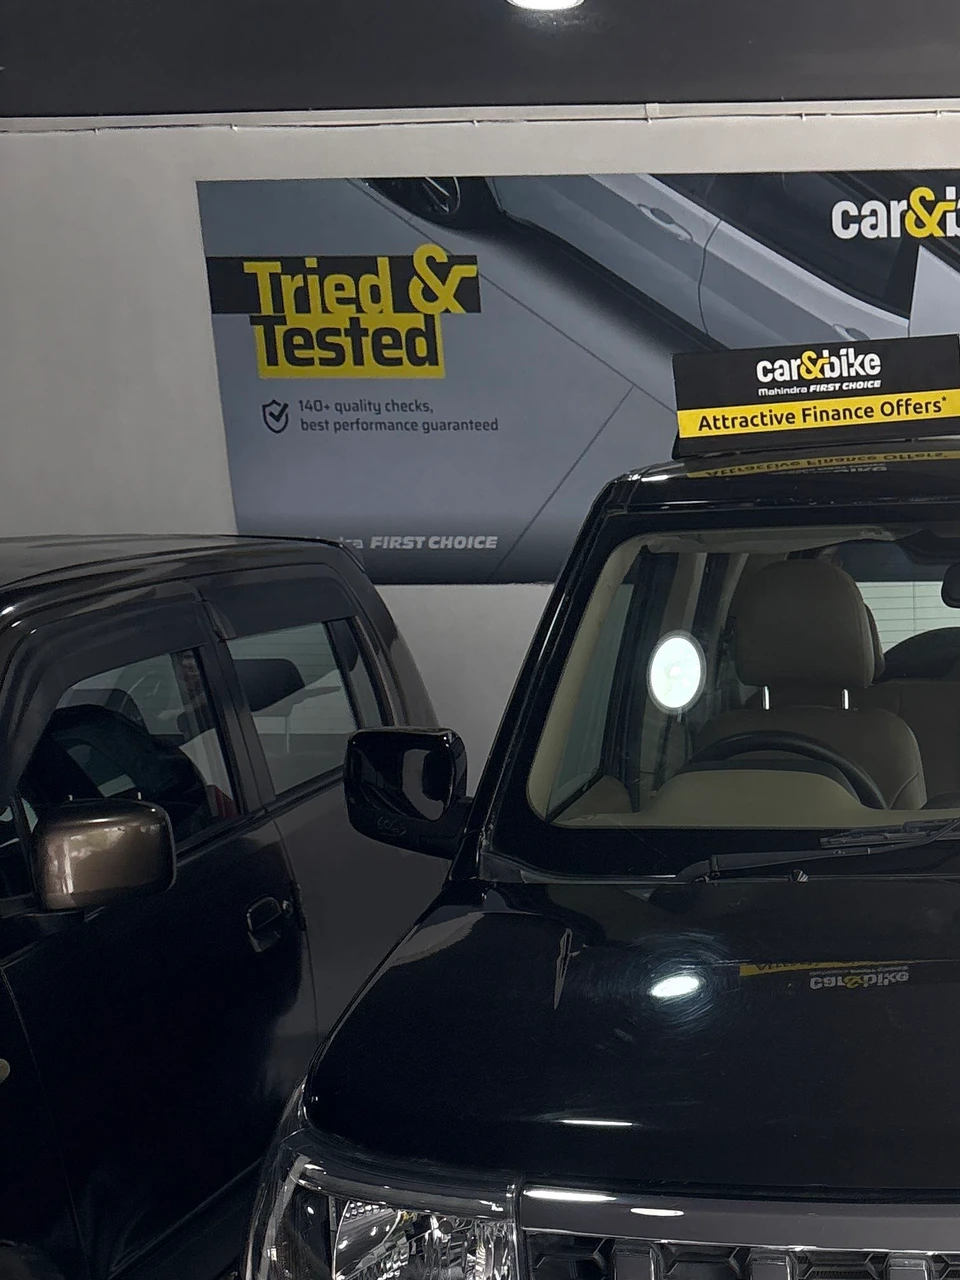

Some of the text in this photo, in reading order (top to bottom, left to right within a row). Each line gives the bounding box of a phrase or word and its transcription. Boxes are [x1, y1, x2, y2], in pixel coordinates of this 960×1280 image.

[243, 243, 478, 315] Tried &
[249, 315, 441, 367] Tested
[756, 347, 881, 383] car&bike
[758, 380, 881, 397] Mahindra FIRST CHOICE
[298, 399, 434, 415] 140+ quality checks,
[697, 410, 796, 433] Attractive
[800, 403, 875, 424] Finance
[301, 418, 499, 434] best performance guaranteed
[370, 536, 427, 549] FIRST
[428, 536, 499, 549] CHOICE
